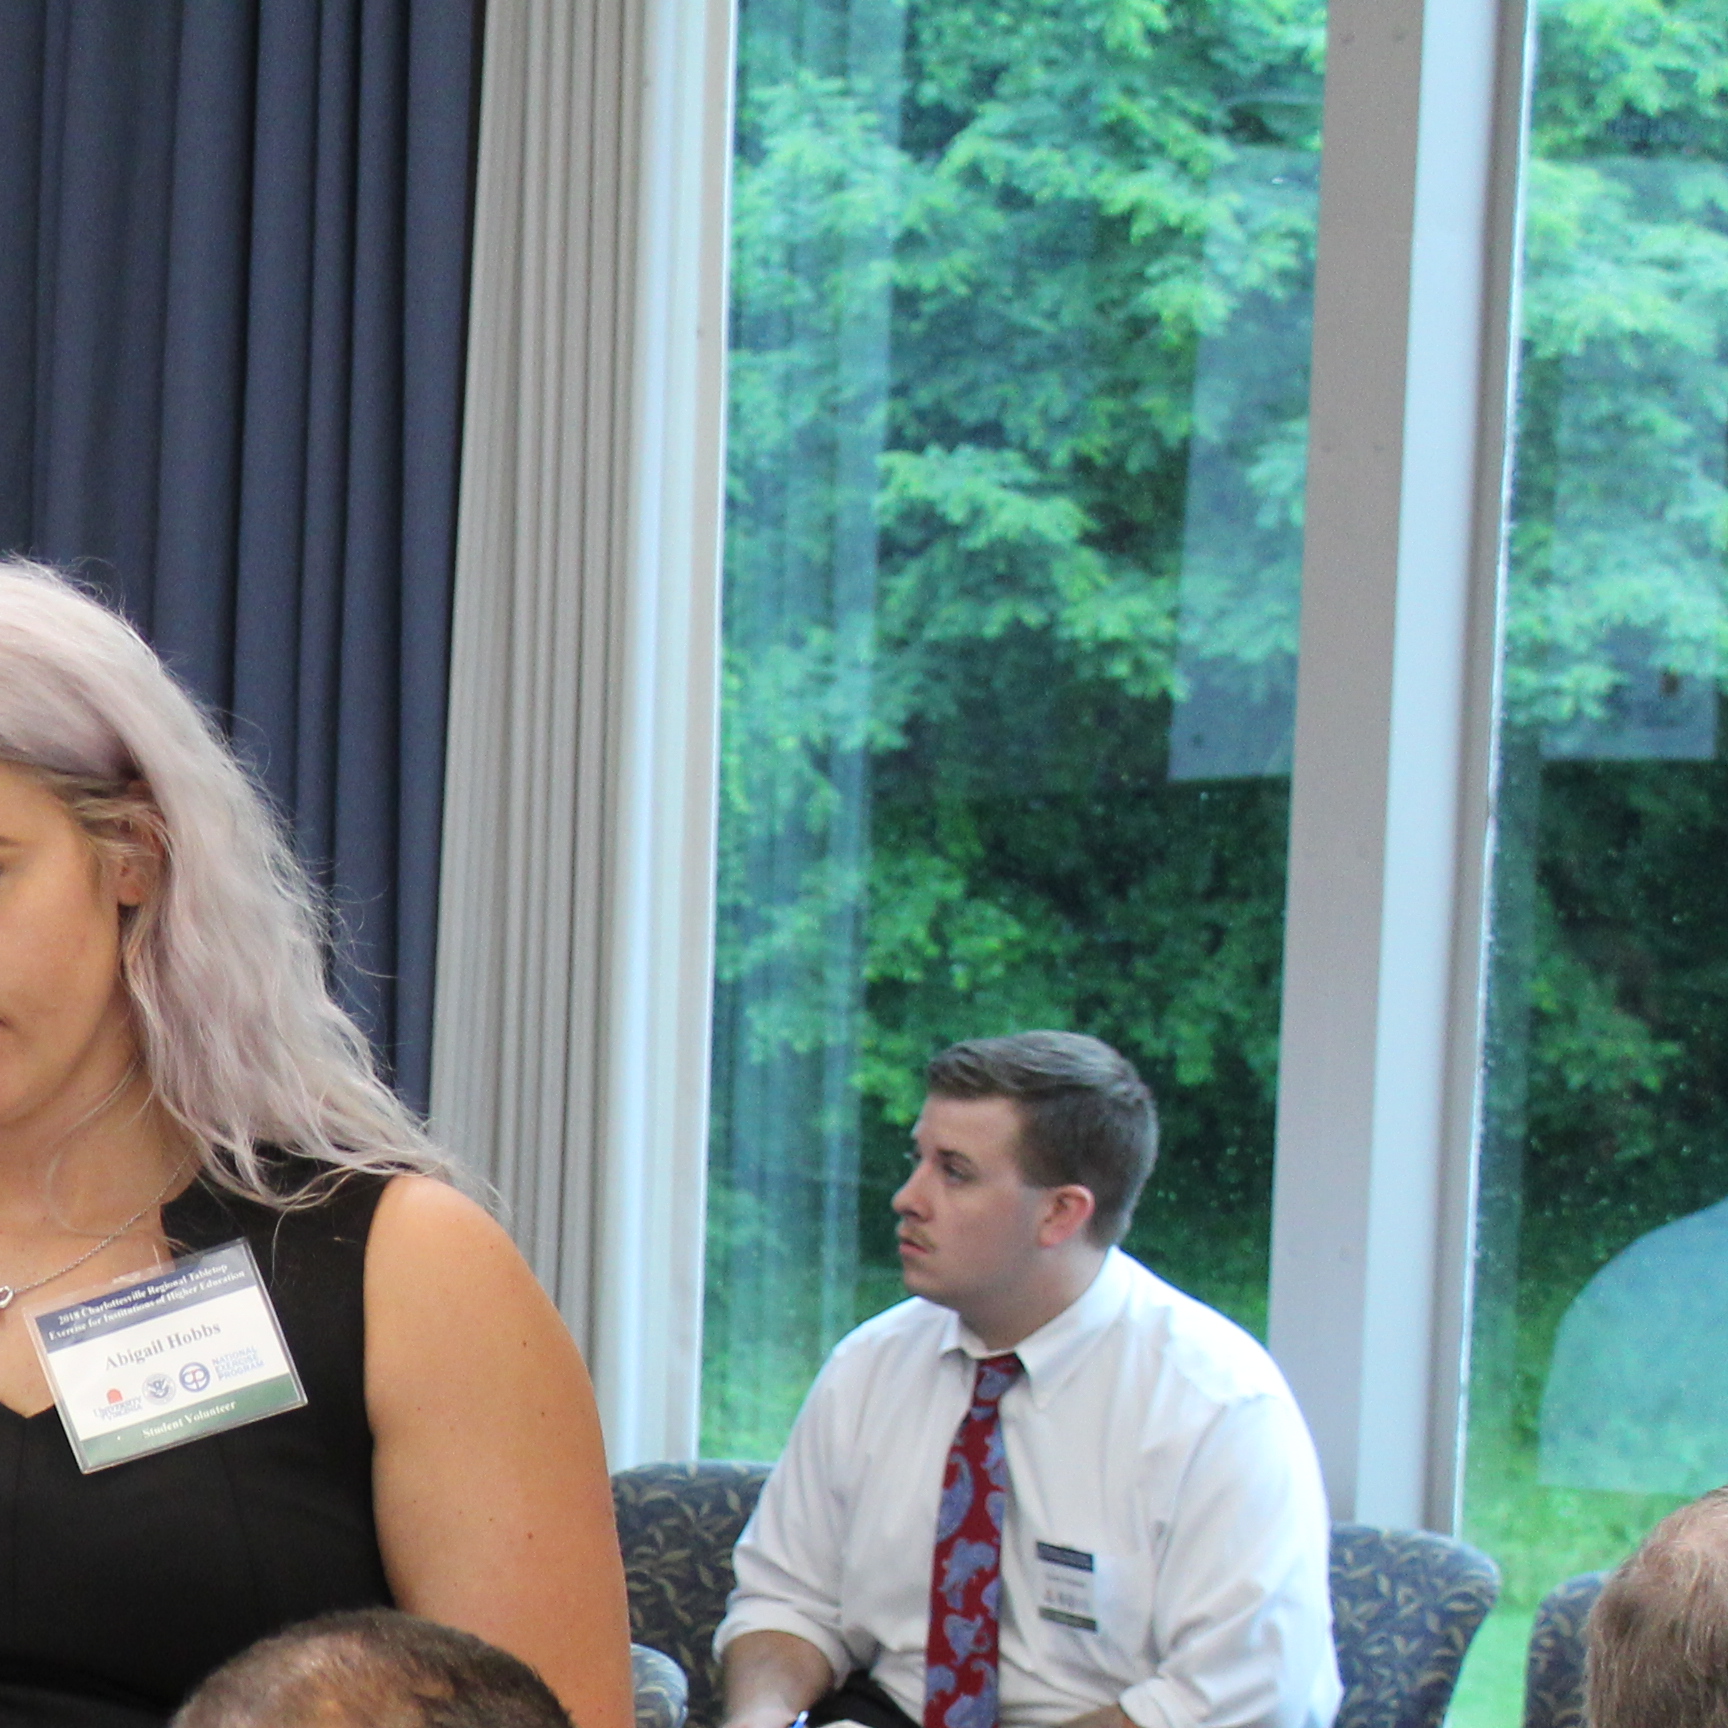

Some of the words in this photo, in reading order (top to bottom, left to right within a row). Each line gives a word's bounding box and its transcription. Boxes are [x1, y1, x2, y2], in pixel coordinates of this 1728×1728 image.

[147, 1275, 188, 1297] Regional
[87, 1316, 102, 1328] for
[165, 1284, 199, 1303] Higher
[198, 1269, 246, 1291] Education
[102, 1339, 166, 1373] Abigail
[166, 1320, 222, 1350] Hobbs
[211, 1345, 257, 1366] NATIONAL
[214, 1353, 260, 1374] EXERCISE
[217, 1360, 265, 1382] PROGRAM
[141, 1417, 184, 1439] Student
[184, 1400, 237, 1425] Volunteer
